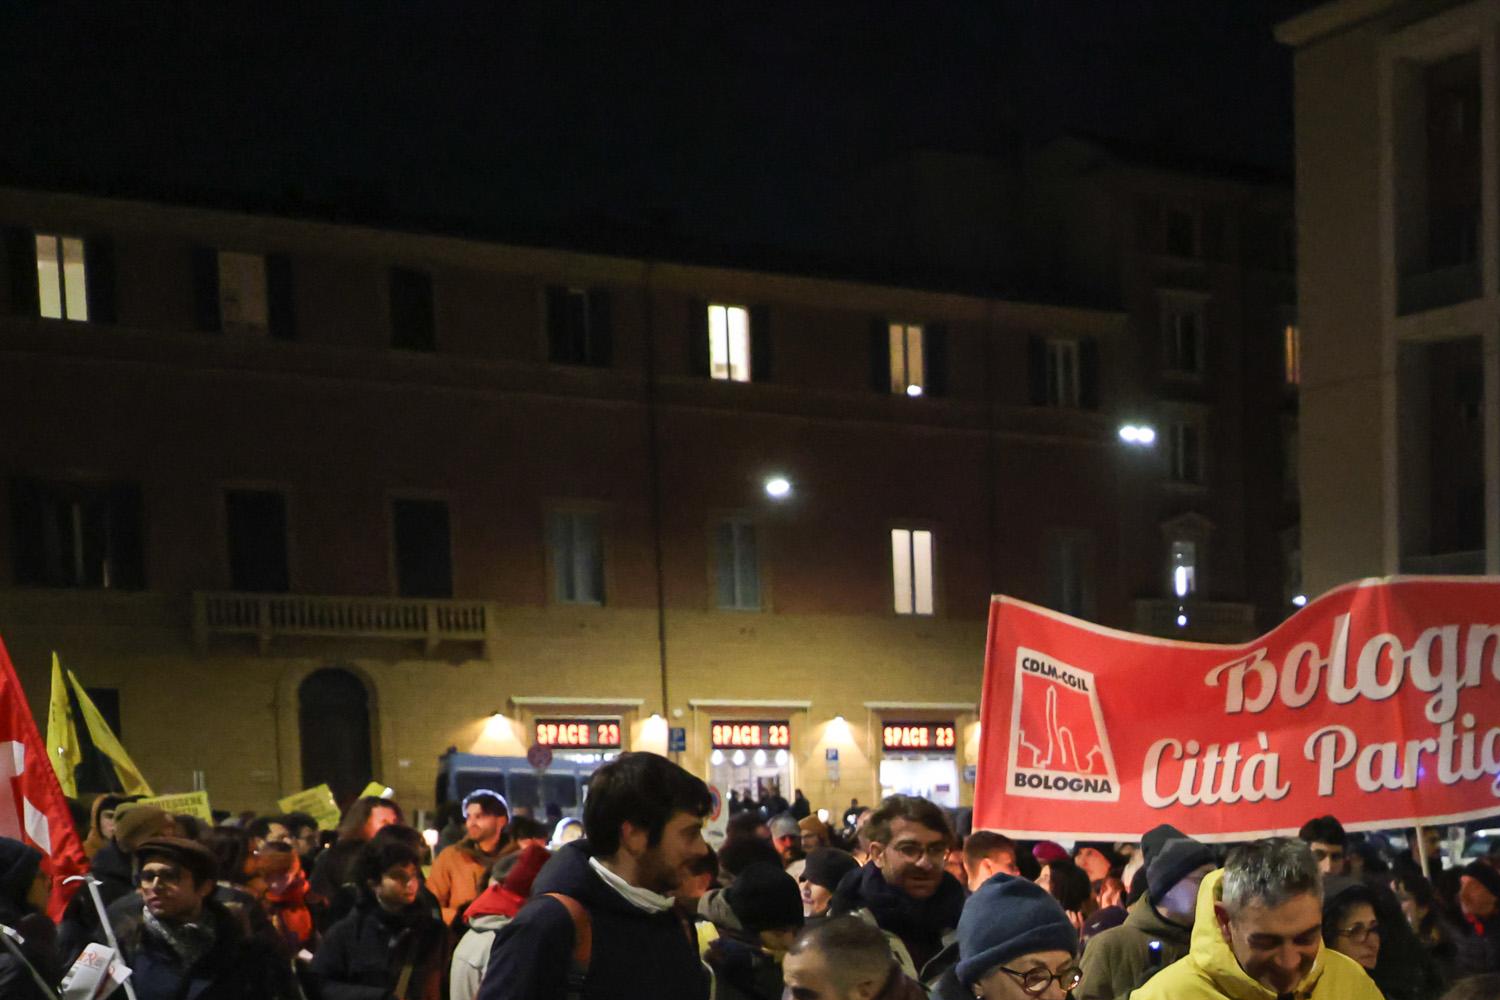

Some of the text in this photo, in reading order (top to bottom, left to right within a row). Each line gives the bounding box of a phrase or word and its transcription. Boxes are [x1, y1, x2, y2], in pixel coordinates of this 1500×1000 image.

[1022, 657, 1089, 692] CDLM-CGIL
[536, 723, 619, 745] SPACE 23
[712, 724, 789, 746] SPACE 23
[883, 726, 955, 747] SPACE 23
[1141, 730, 1291, 809] Città
[1014, 772, 1112, 794] BOLOGNA
